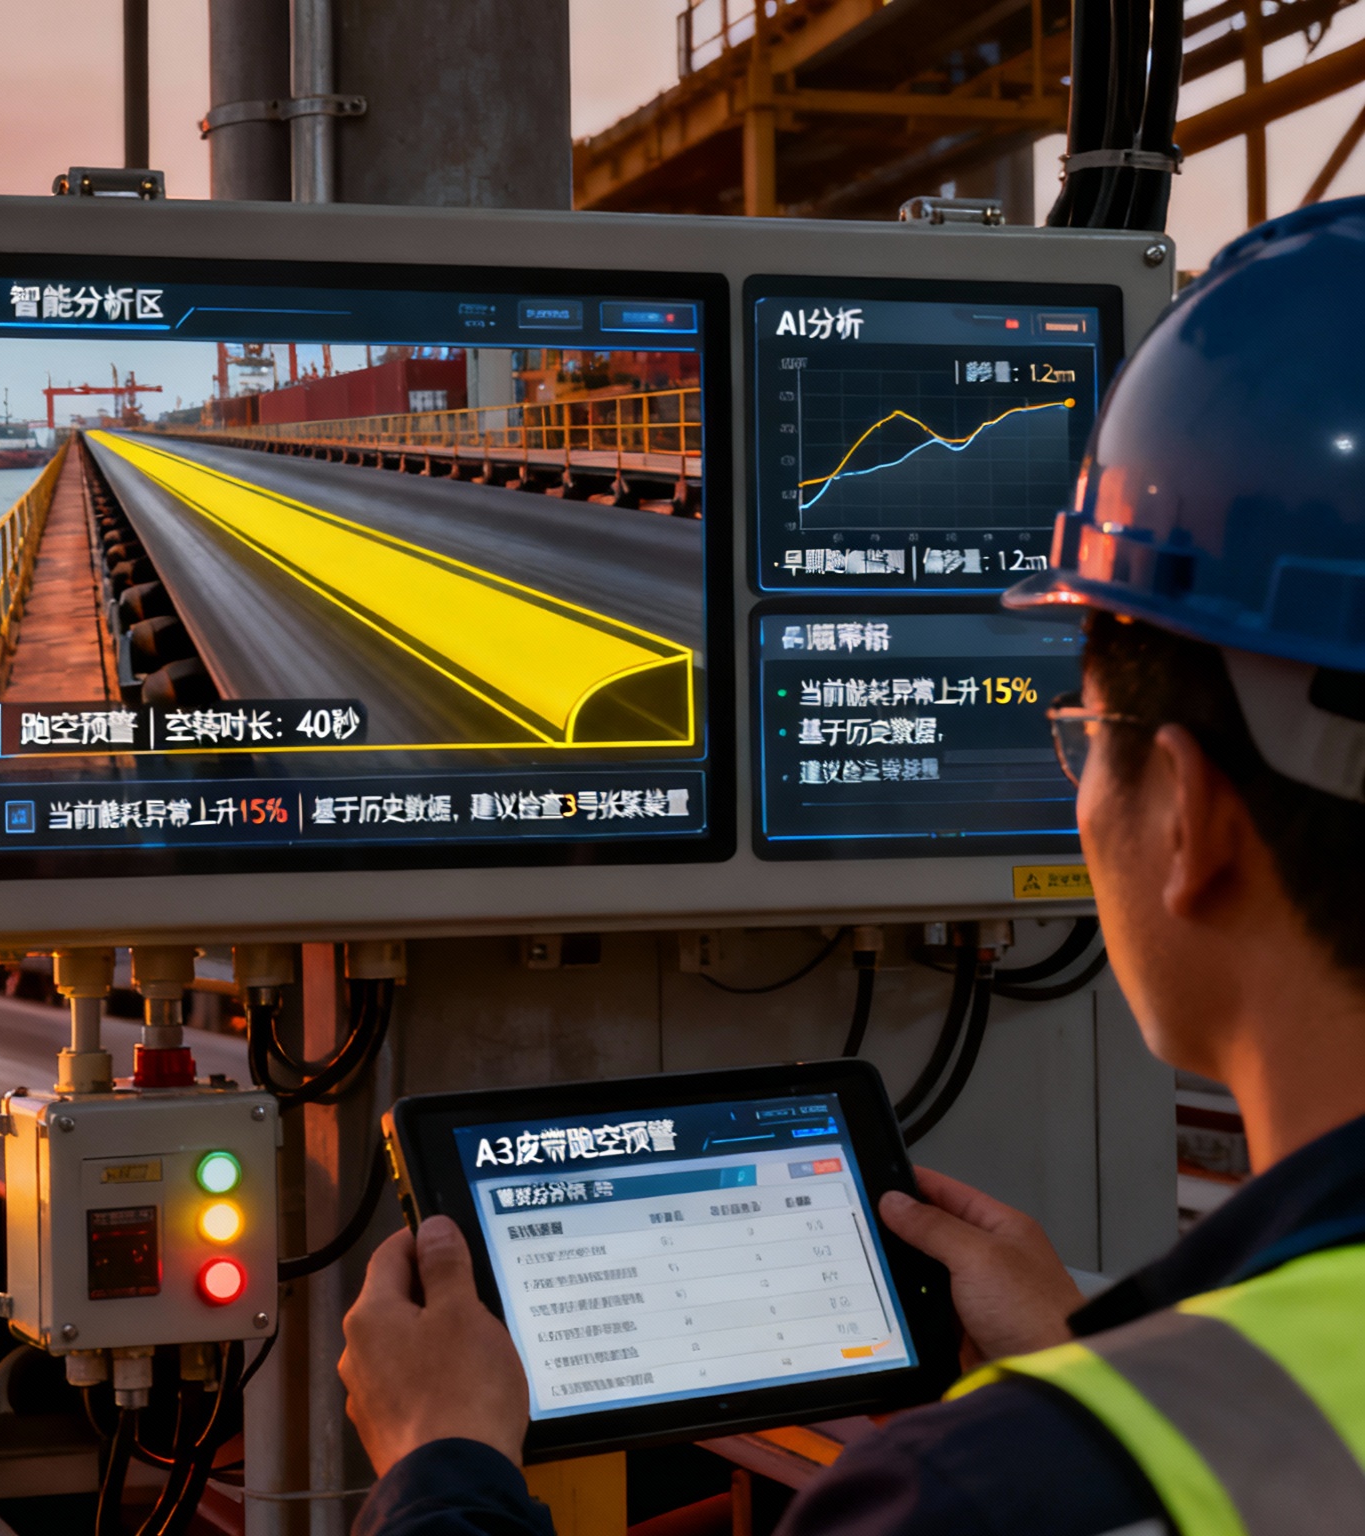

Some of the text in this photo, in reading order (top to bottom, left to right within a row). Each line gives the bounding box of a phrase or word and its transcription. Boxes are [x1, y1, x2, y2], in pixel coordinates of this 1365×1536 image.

[10, 283, 164, 320] 智能分析区
[776, 307, 864, 339] AI分析
[21, 709, 138, 745] 跑空预警
